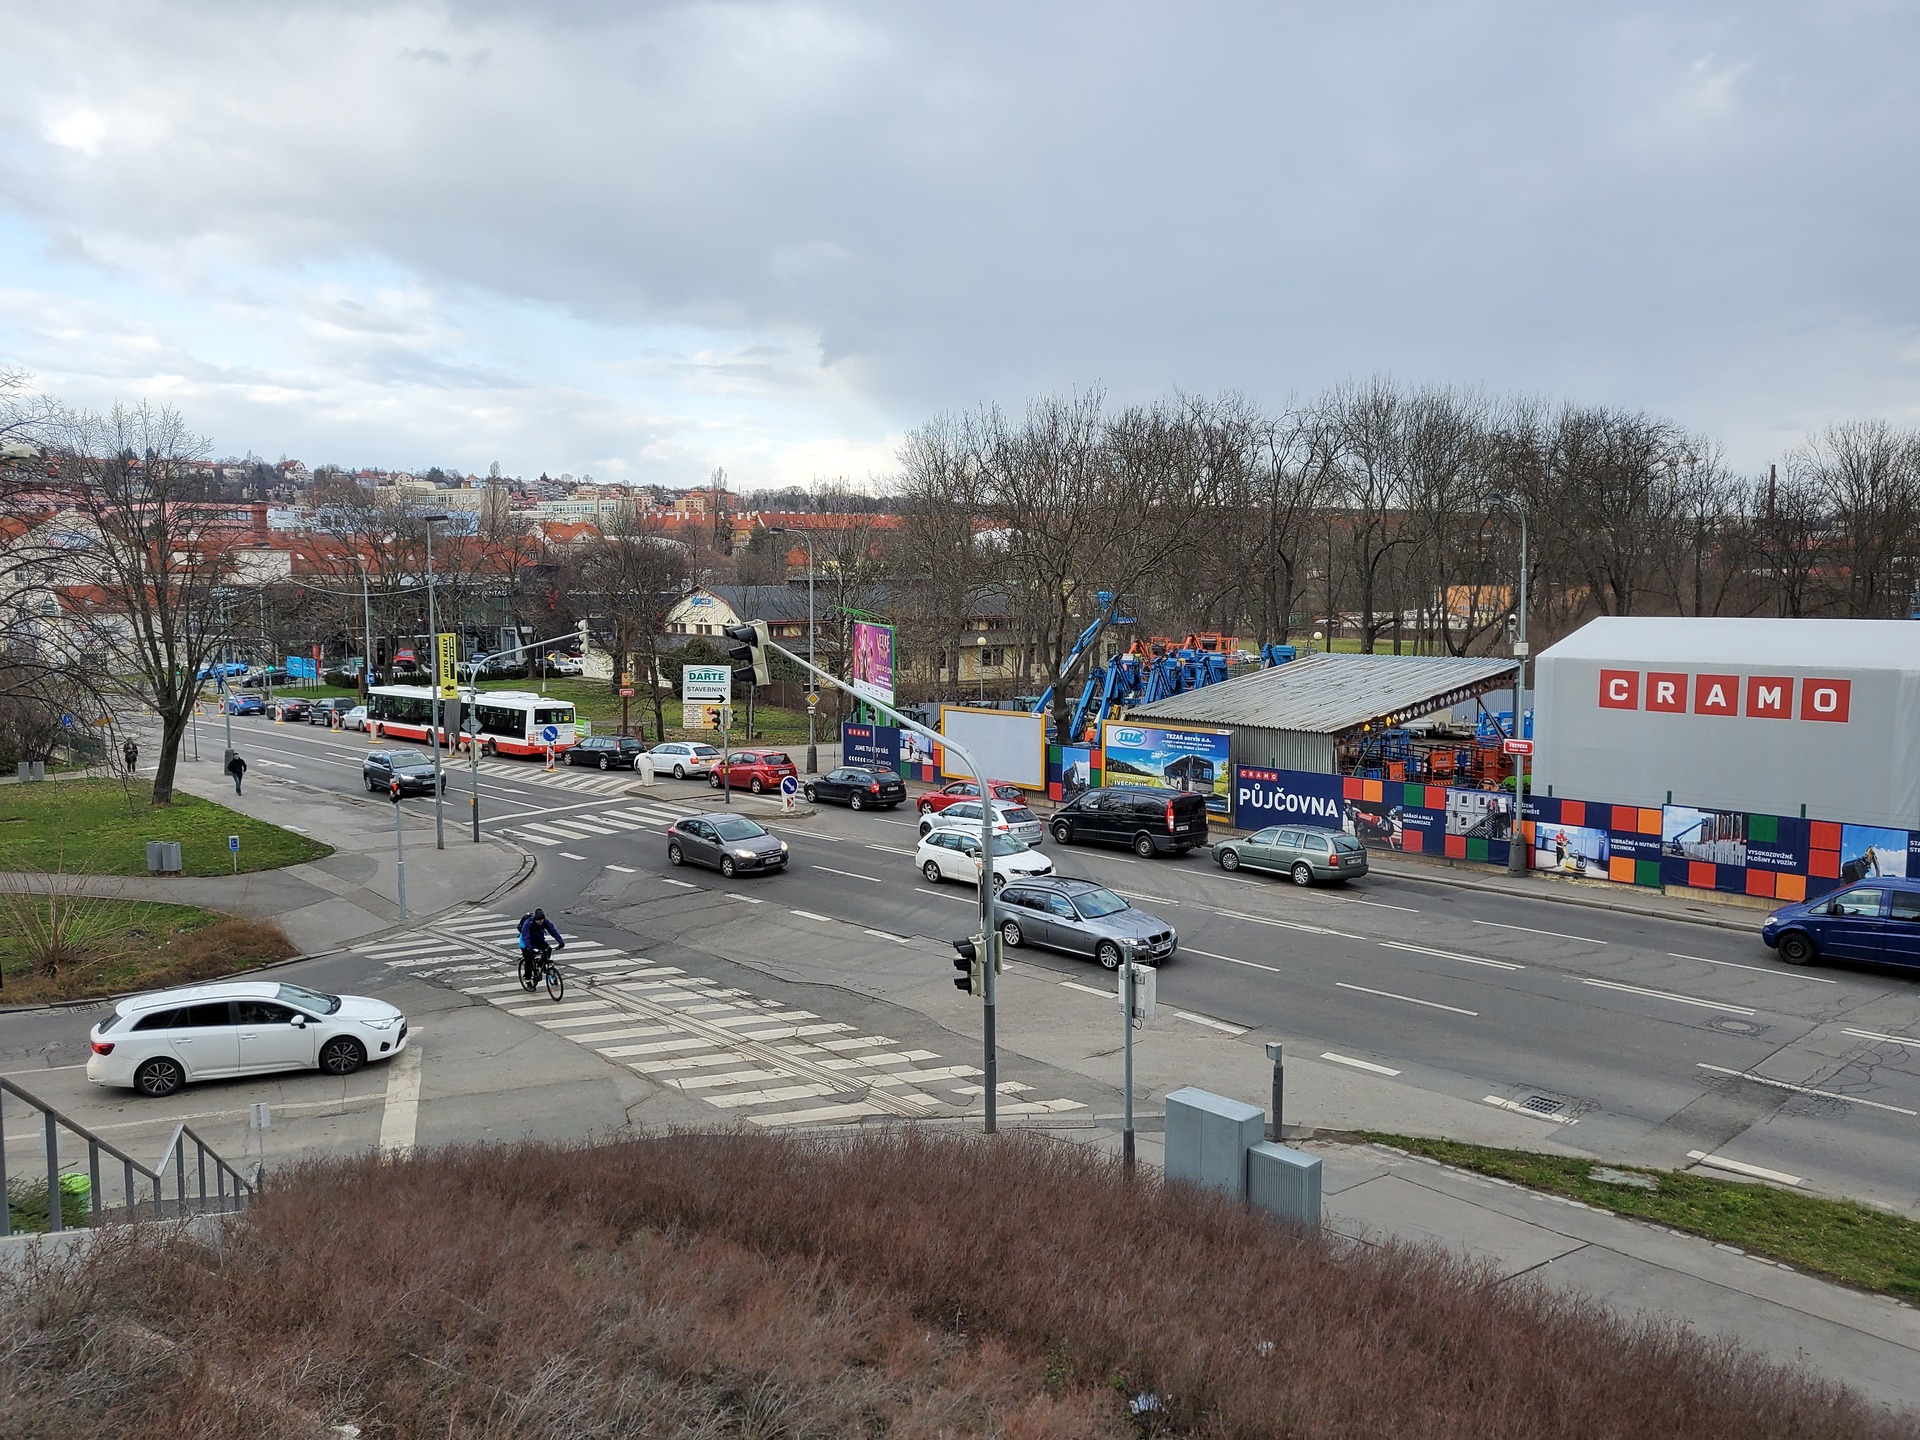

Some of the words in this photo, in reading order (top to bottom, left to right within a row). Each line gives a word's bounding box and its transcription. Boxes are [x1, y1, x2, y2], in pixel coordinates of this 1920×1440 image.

[1609, 678, 1838, 712] CRAMO
[1241, 770, 1277, 779] CRAMO
[1240, 783, 1339, 818] PŮJČOVNA
[1748, 849, 1793, 860] VYSOKOZDVIŽNÉ
